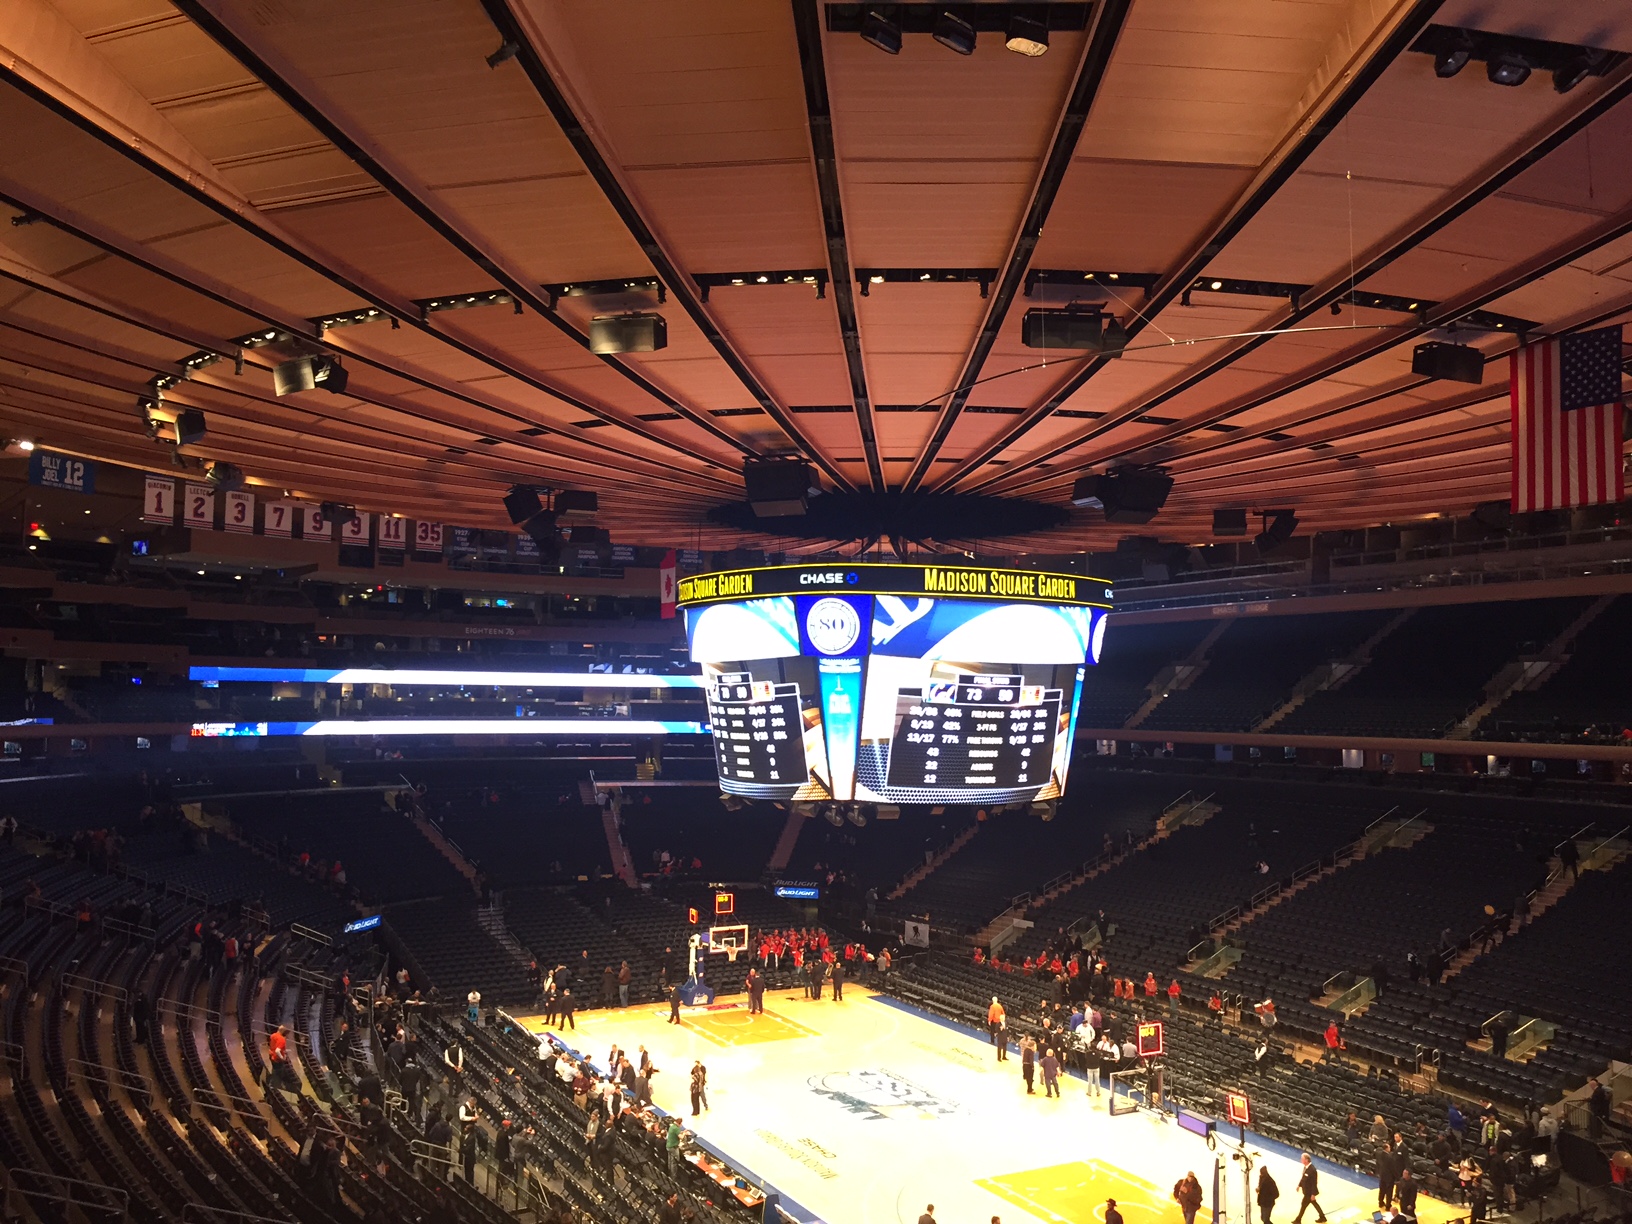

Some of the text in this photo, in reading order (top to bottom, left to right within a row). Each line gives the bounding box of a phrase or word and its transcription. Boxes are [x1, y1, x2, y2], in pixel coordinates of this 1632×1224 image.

[41, 455, 61, 470] BILLY
[42, 468, 60, 482] JOEL
[64, 460, 85, 487] 12
[154, 491, 164, 514] 1
[193, 497, 206, 519] 2
[234, 502, 246, 523] 3
[273, 507, 285, 528] 7
[312, 512, 324, 532] 9
[350, 517, 362, 536] 9
[384, 519, 401, 540] 11
[418, 522, 441, 543] 35
[694, 578, 717, 599] SQUARE
[719, 574, 753, 596] GARDEN
[800, 573, 844, 585] CHASE
[924, 568, 987, 592] MADISON
[990, 571, 1035, 596] SQUARE
[1038, 574, 1076, 599] GARDEN
[465, 627, 504, 635] EIGHTEEN
[505, 628, 515, 636] 76
